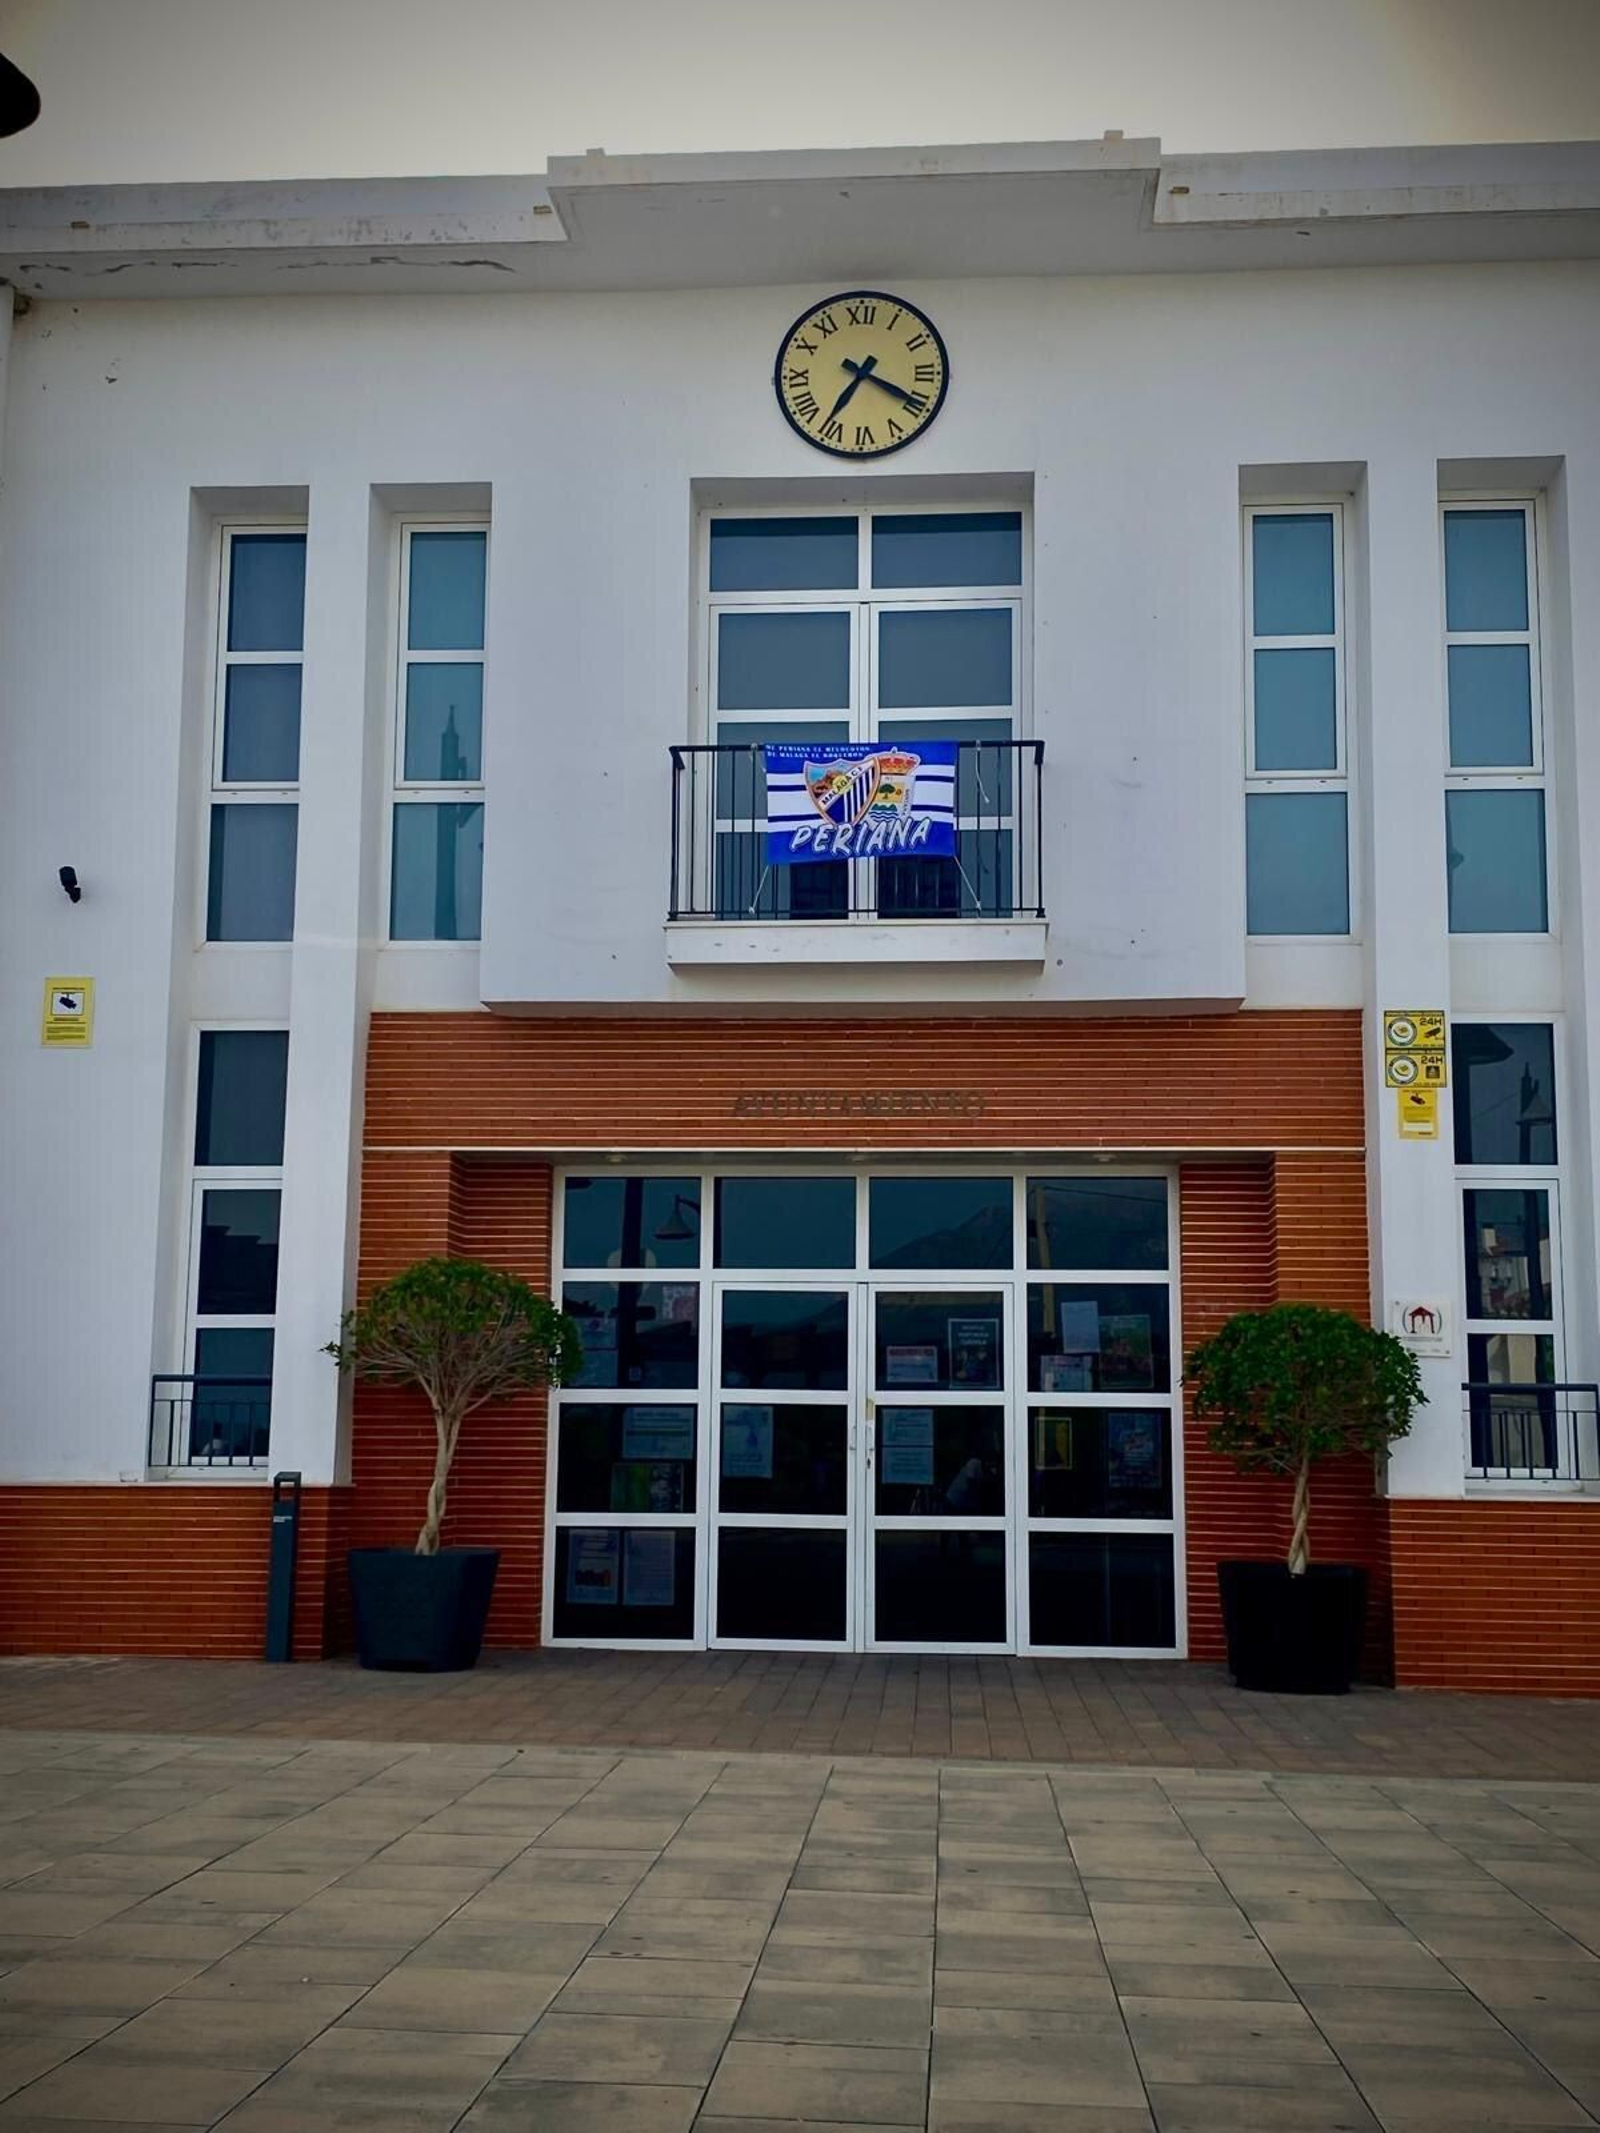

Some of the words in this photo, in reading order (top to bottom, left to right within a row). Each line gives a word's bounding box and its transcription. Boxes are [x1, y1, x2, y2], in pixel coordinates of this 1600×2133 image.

[846, 305, 876, 326] XII
[886, 313, 899, 331] I
[812, 314, 838, 340] XI
[795, 337, 819, 356] X
[906, 333, 927, 352] II
[789, 368, 809, 388] IX
[914, 363, 934, 383] III
[792, 391, 820, 424] VIII
[855, 426, 875, 446] VI
[886, 418, 904, 438] V
[790, 817, 932, 856] PERIANA
[1419, 1017, 1442, 1026] 24H
[1420, 1055, 1443, 1064] 24H
